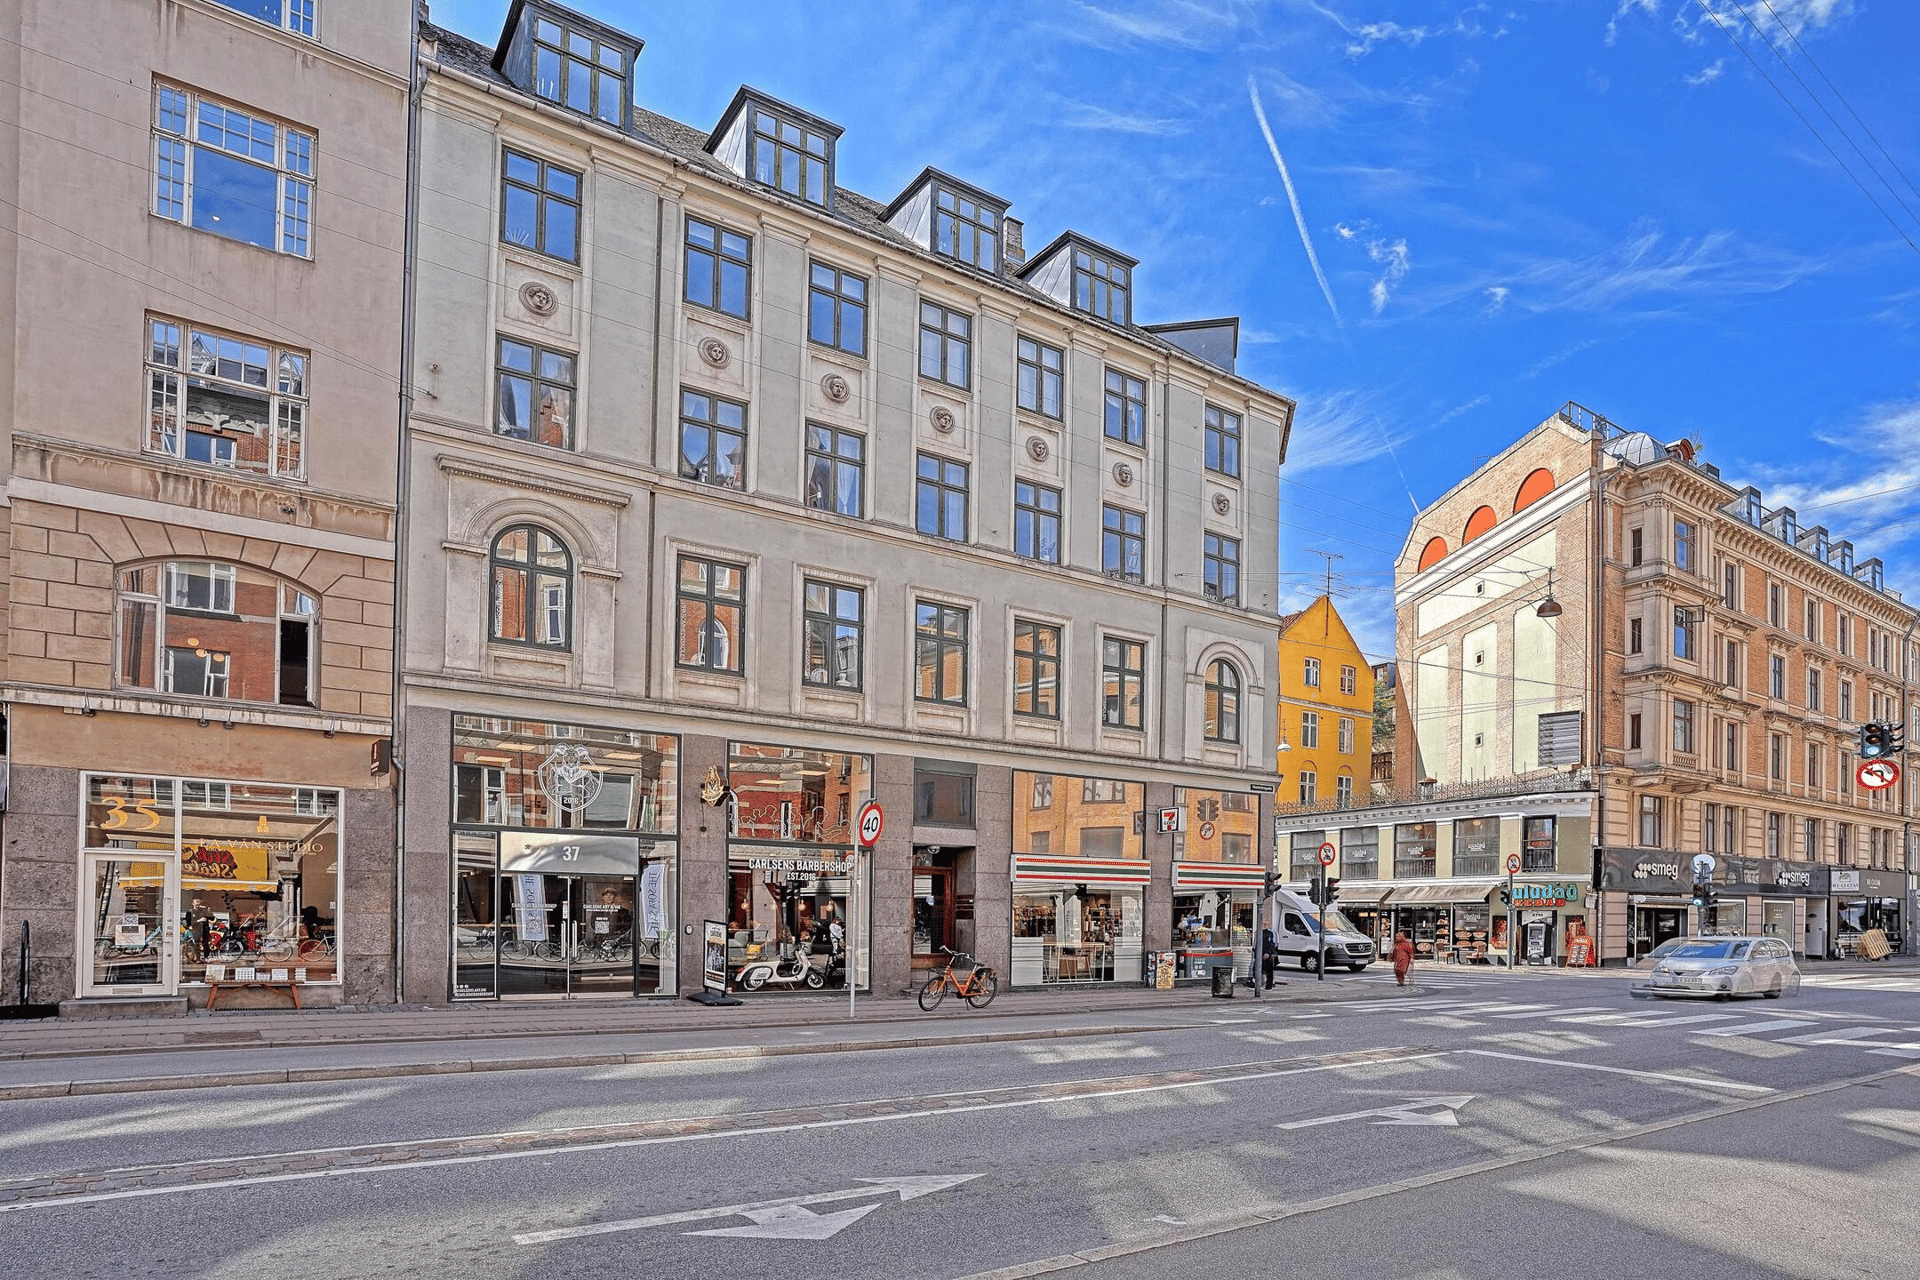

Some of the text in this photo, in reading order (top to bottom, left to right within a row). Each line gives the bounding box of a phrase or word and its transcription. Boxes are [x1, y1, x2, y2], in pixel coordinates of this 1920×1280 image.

[563, 796, 579, 805] 2016
[100, 796, 161, 830] 35
[863, 816, 879, 833] 40
[267, 841, 324, 853] STUDIO
[562, 845, 580, 862] 37
[748, 858, 852, 873] CARLSENS BARBERSHOP
[1651, 862, 1679, 881] smeg
[1790, 871, 1810, 887] smeg
